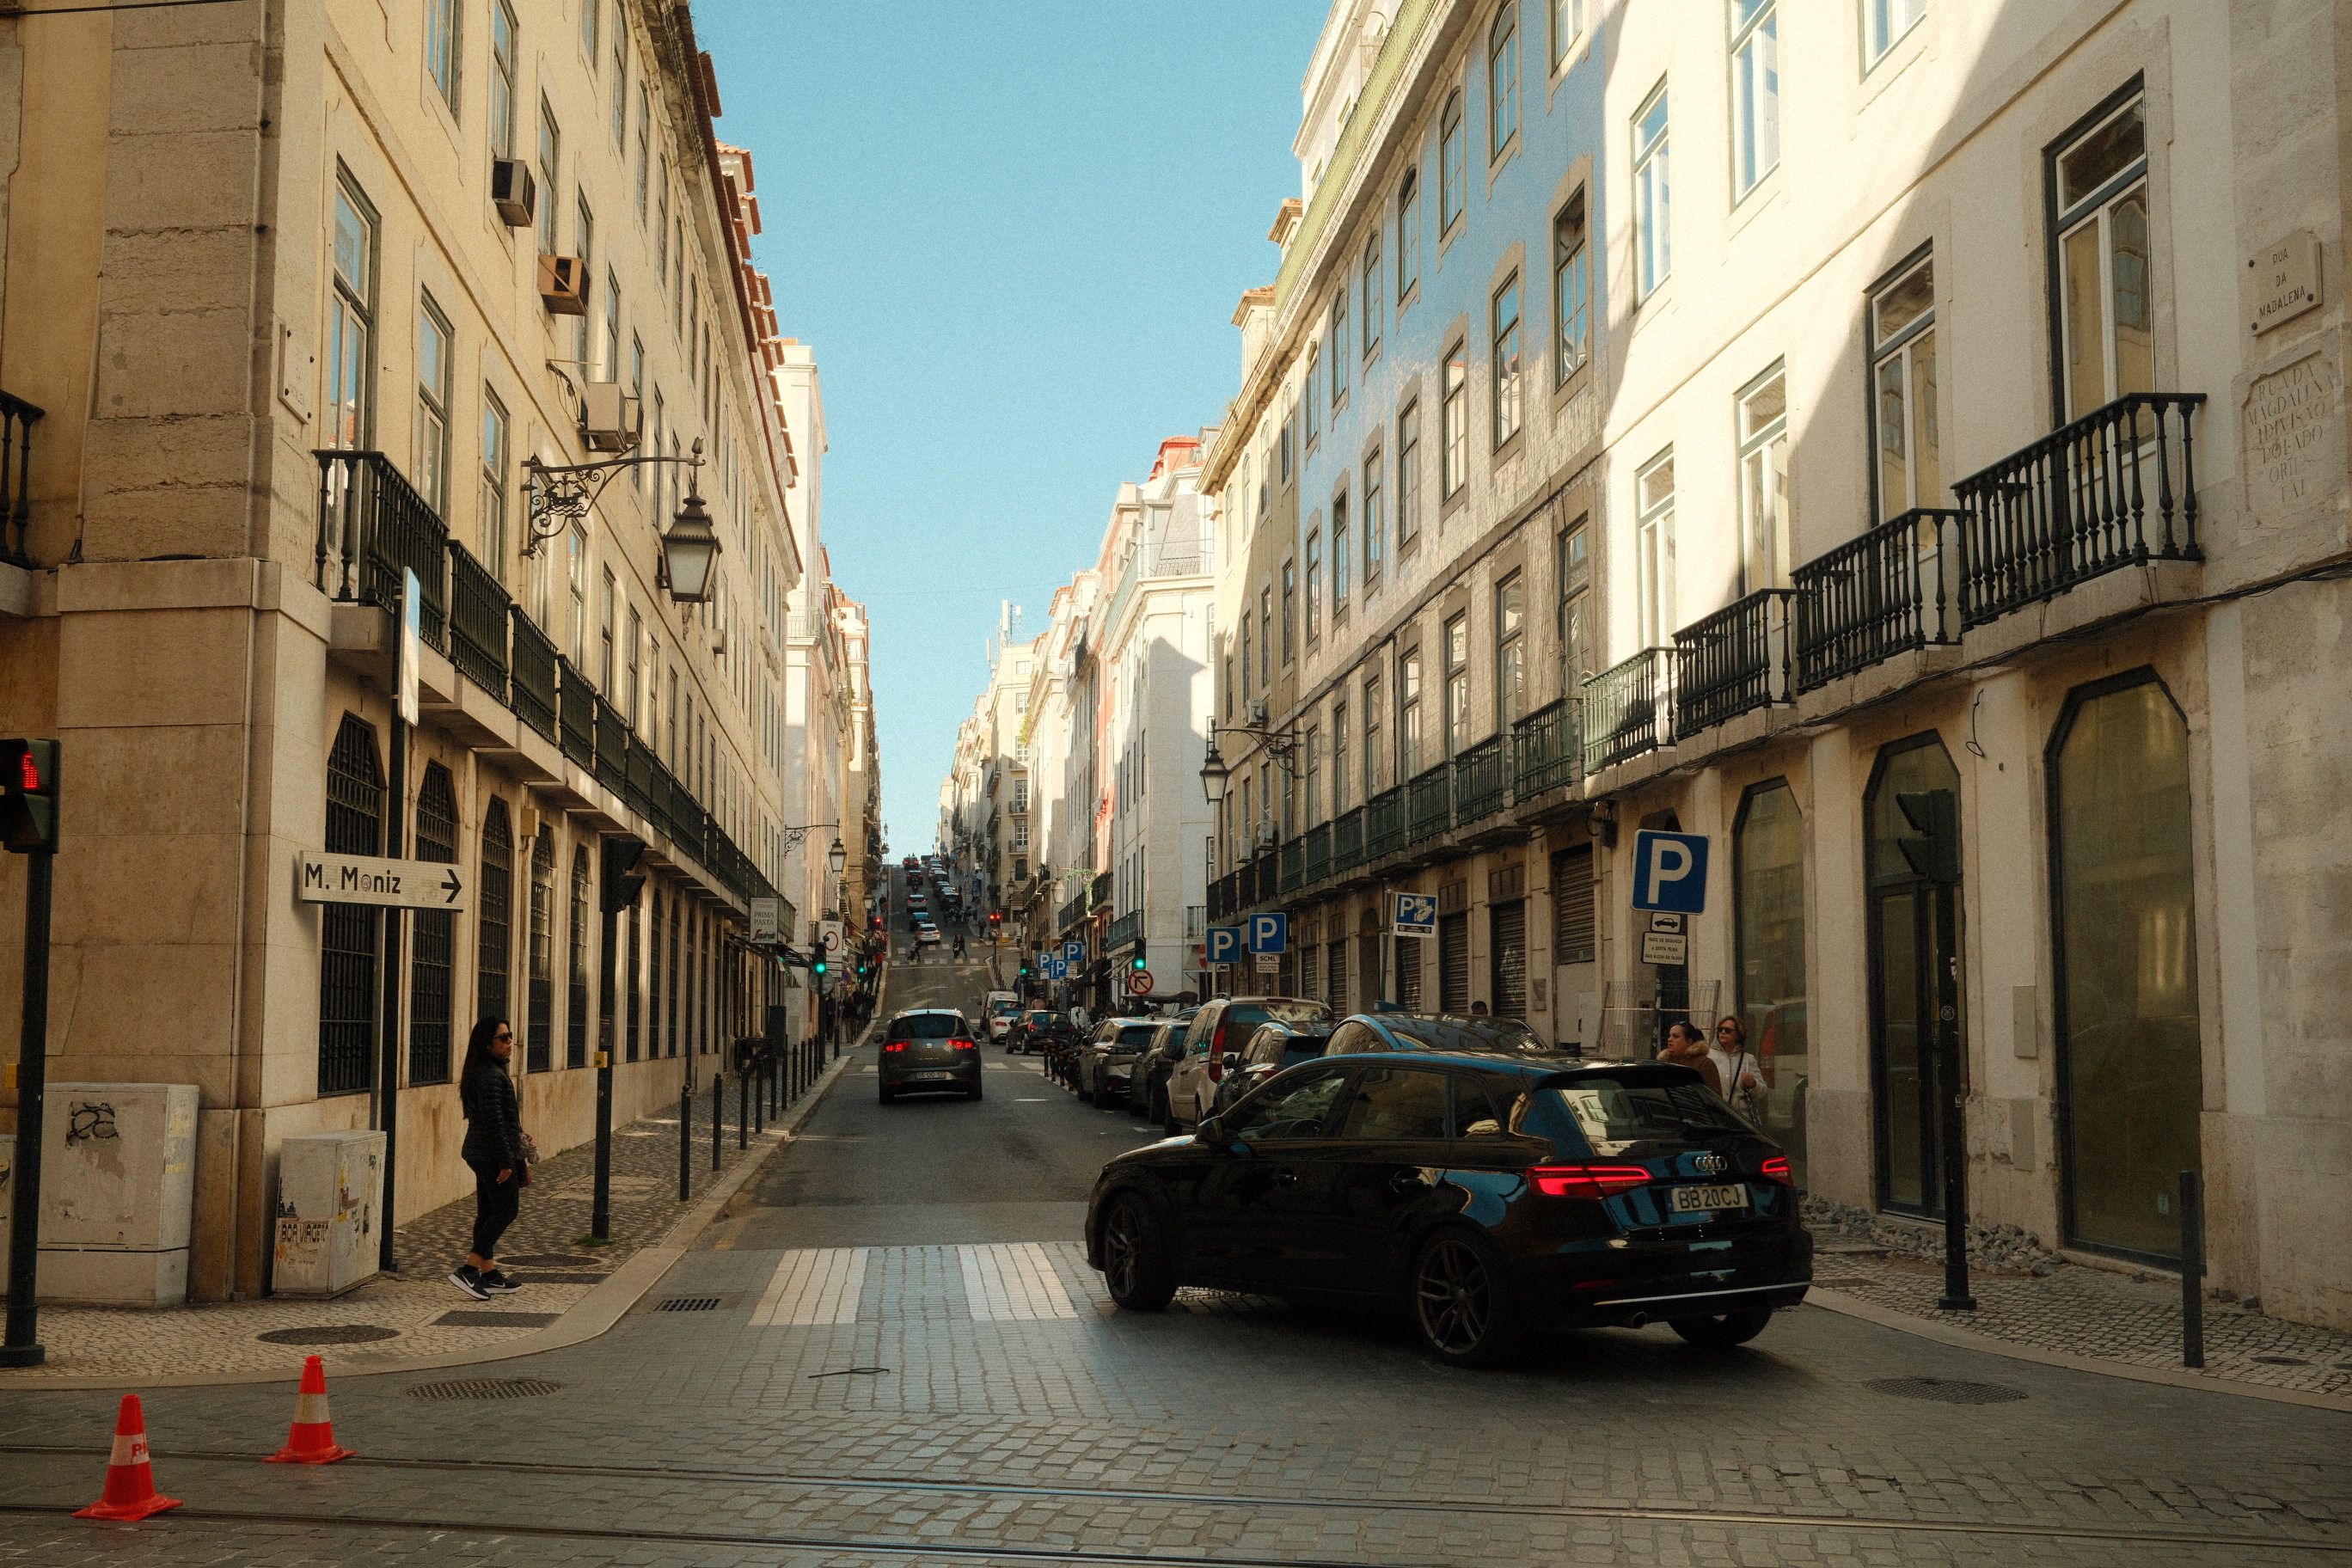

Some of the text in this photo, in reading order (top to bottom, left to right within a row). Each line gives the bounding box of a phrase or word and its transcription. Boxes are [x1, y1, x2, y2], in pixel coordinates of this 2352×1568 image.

[2272, 248, 2288, 265] RUA
[2275, 272, 2288, 287] DA
[2259, 285, 2306, 318] MADALENA
[304, 863, 401, 895] M. Moniz
[1646, 838, 1694, 904] P
[1400, 897, 1415, 917] P
[1256, 917, 1277, 950] P
[1067, 944, 1078, 960] P
[1213, 931, 1234, 959] P
[1039, 954, 1050, 968] P
[1056, 960, 1066, 976] P
[282, 1223, 298, 1243] BOA
